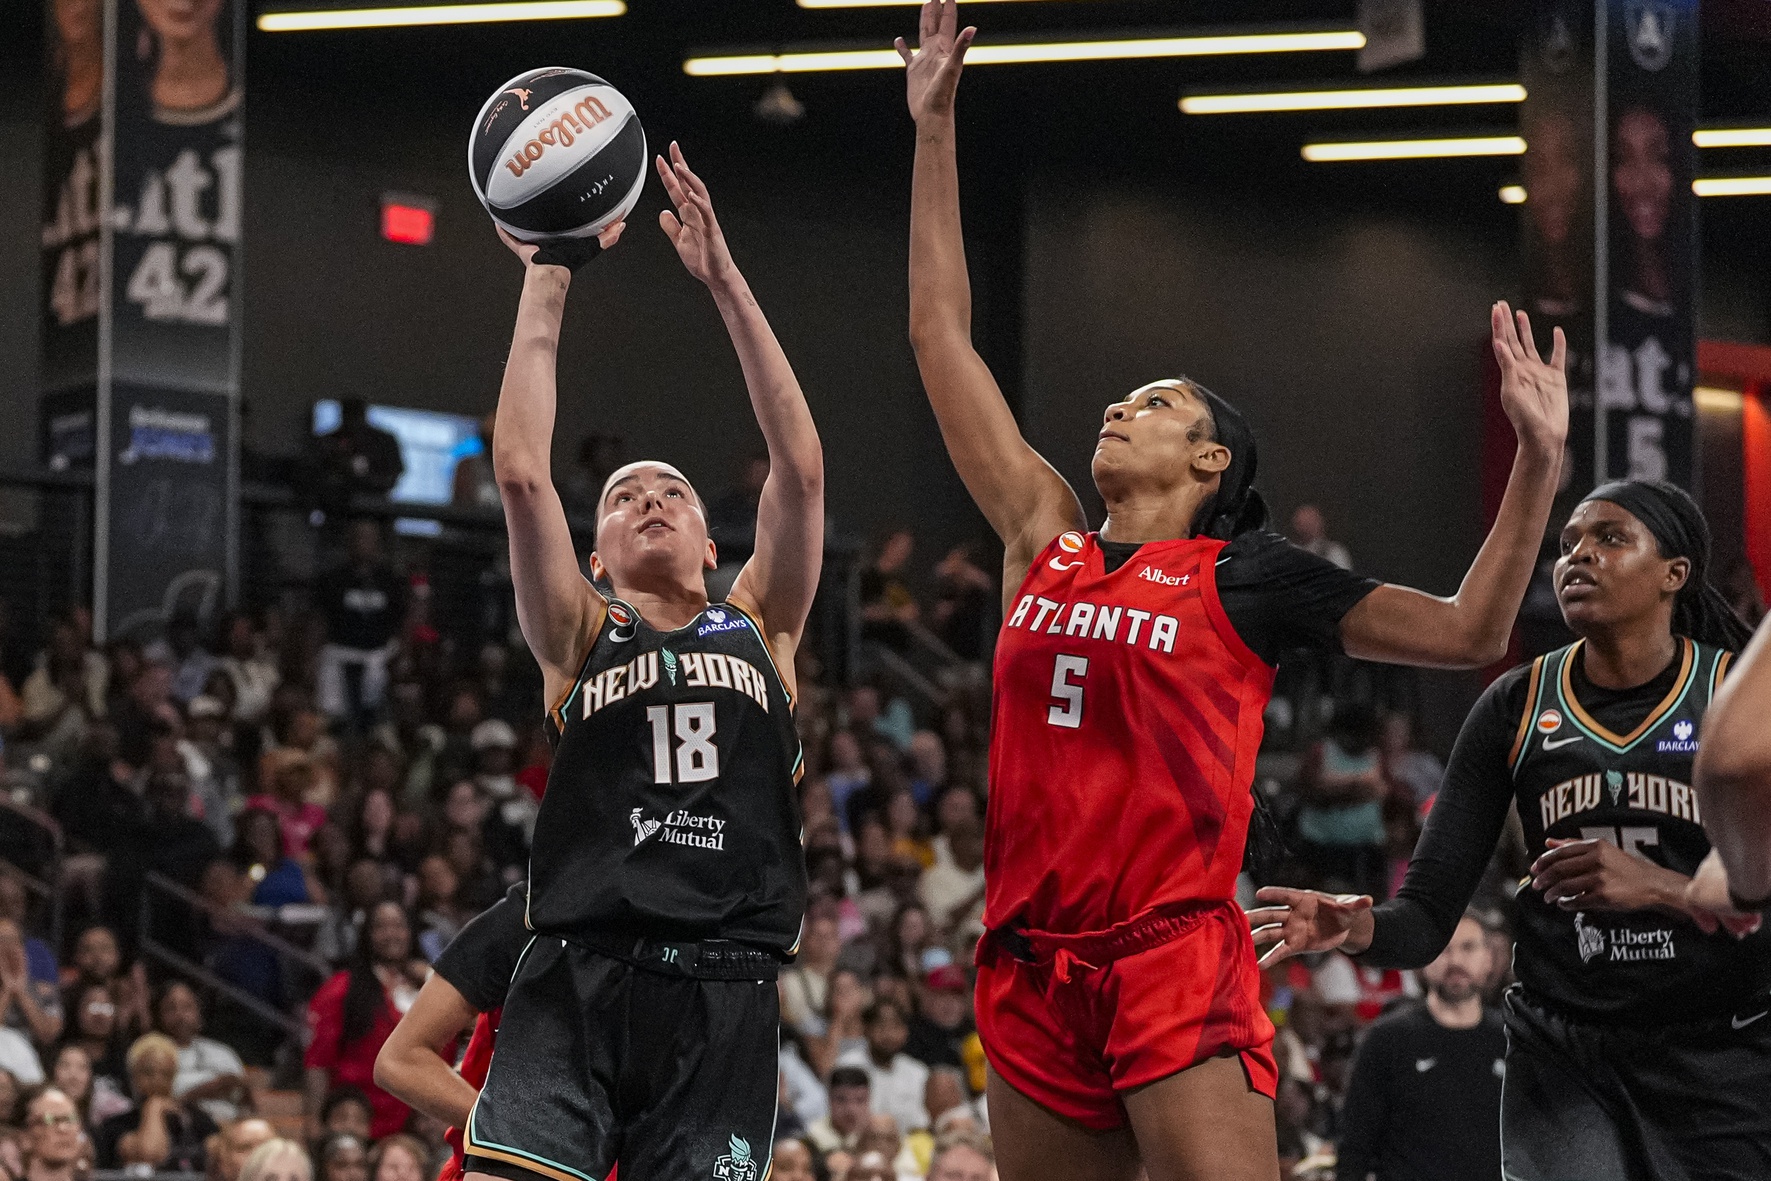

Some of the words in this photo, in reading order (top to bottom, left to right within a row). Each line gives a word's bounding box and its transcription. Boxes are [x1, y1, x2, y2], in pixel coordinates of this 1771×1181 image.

[504, 96, 613, 178] Wilson
[128, 242, 228, 325] 42
[1138, 566, 1190, 586] Albert
[698, 619, 746, 636] BARCLAYS
[1008, 594, 1179, 653] ATLANTA
[582, 651, 659, 720] NEW
[679, 653, 768, 713] YORK
[1047, 654, 1088, 728] 5
[646, 702, 719, 784] 18
[1658, 741, 1700, 751] BARCLAY
[1540, 774, 1601, 831] NEW
[658, 828, 724, 850] Mutual
[664, 811, 725, 836] Liberty
[1610, 929, 1673, 946] Liberty
[1610, 942, 1675, 961] Mutual
